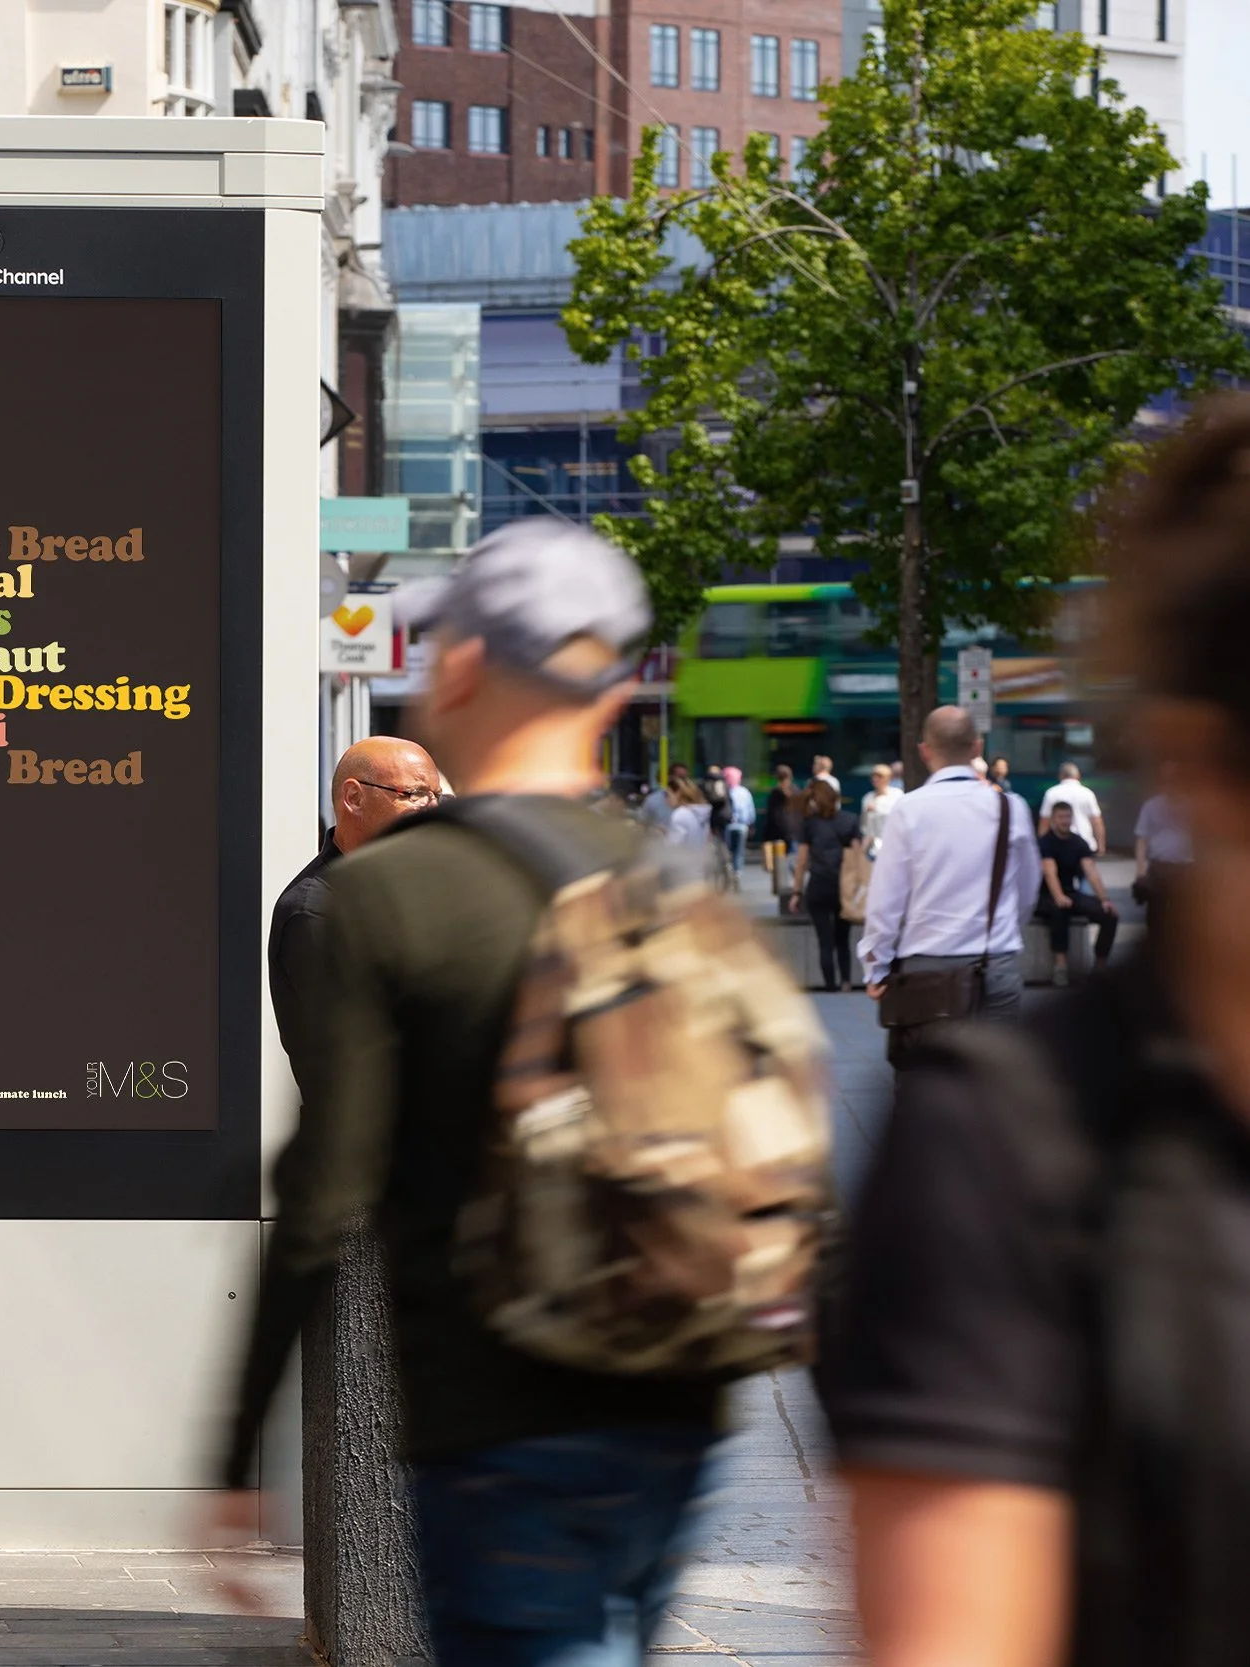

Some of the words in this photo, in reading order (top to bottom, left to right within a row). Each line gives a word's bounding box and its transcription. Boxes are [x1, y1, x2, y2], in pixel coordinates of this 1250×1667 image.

[8, 526, 145, 562] Bread
[7, 750, 144, 785] Bread
[32, 1089, 68, 1099] lunch
[86, 1062, 98, 1099] YOUR
[99, 1061, 189, 1099] M&S
